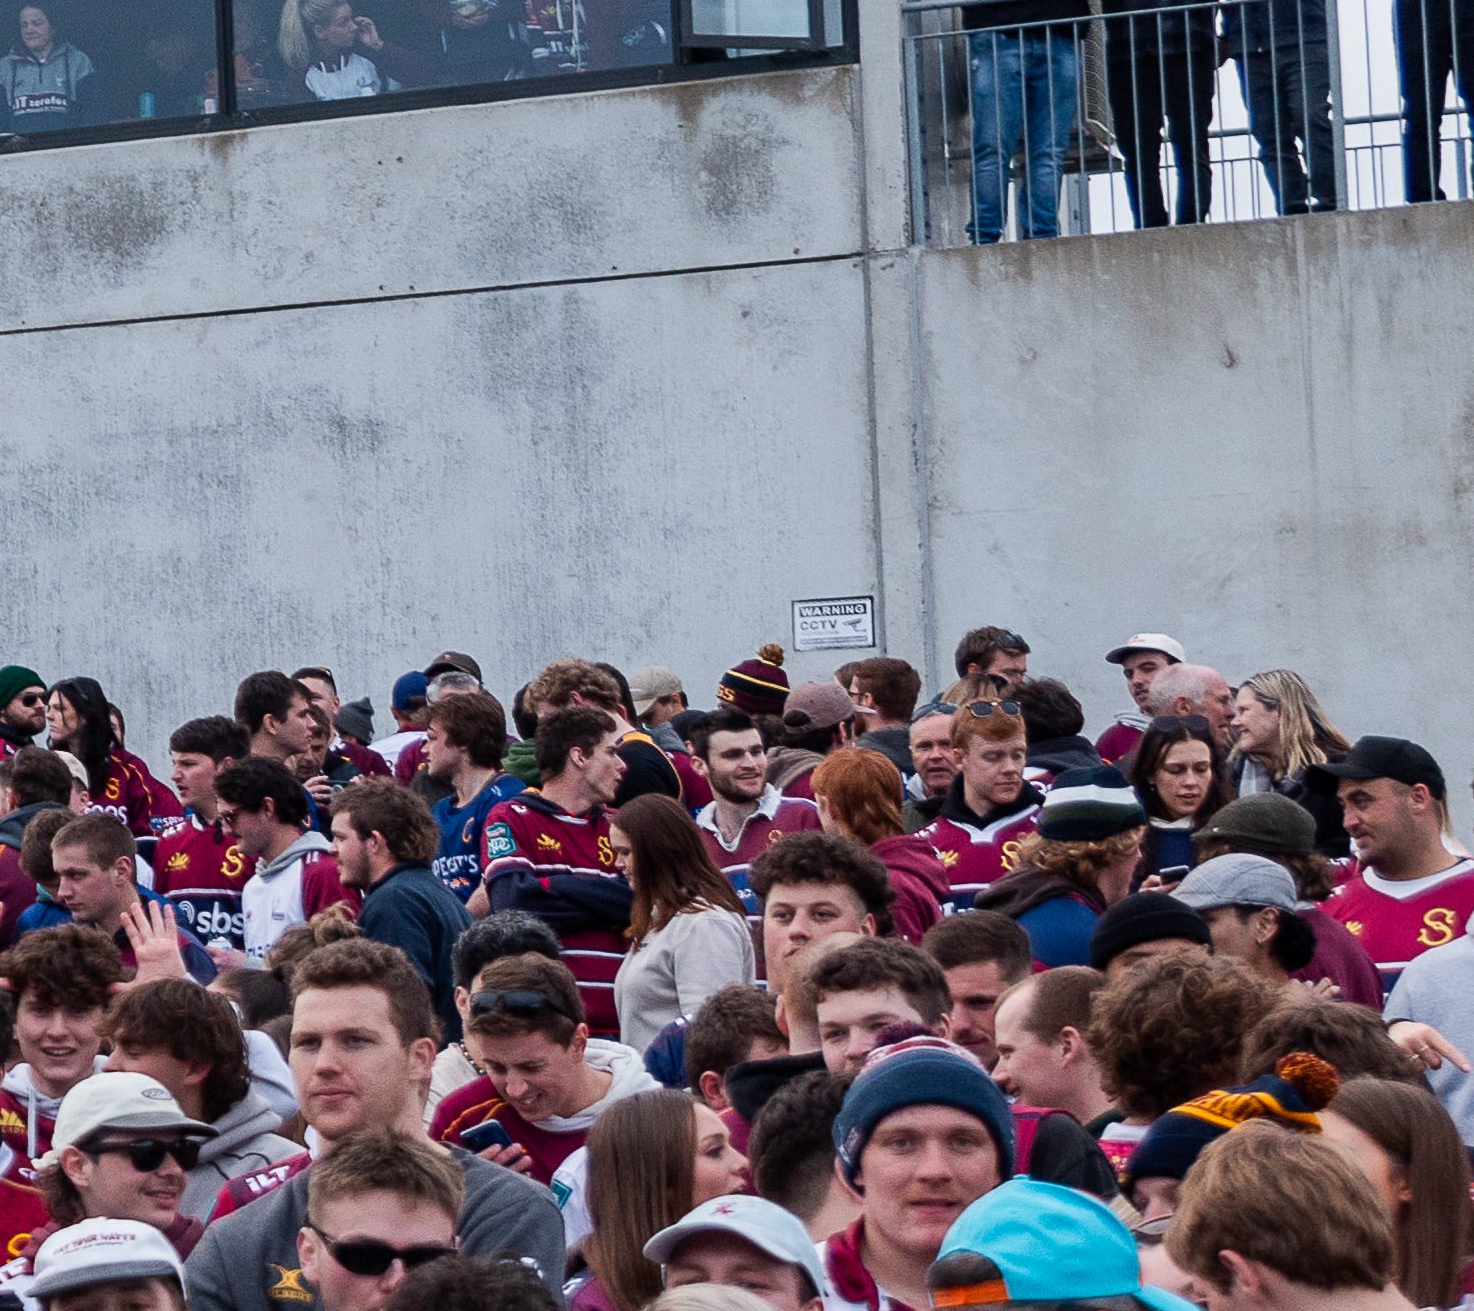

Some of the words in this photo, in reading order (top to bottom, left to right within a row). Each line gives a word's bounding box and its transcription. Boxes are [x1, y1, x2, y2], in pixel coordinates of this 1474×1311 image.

[799, 603, 866, 618] WARNING
[799, 619, 838, 631] CCTV
[196, 900, 245, 936] sbs
